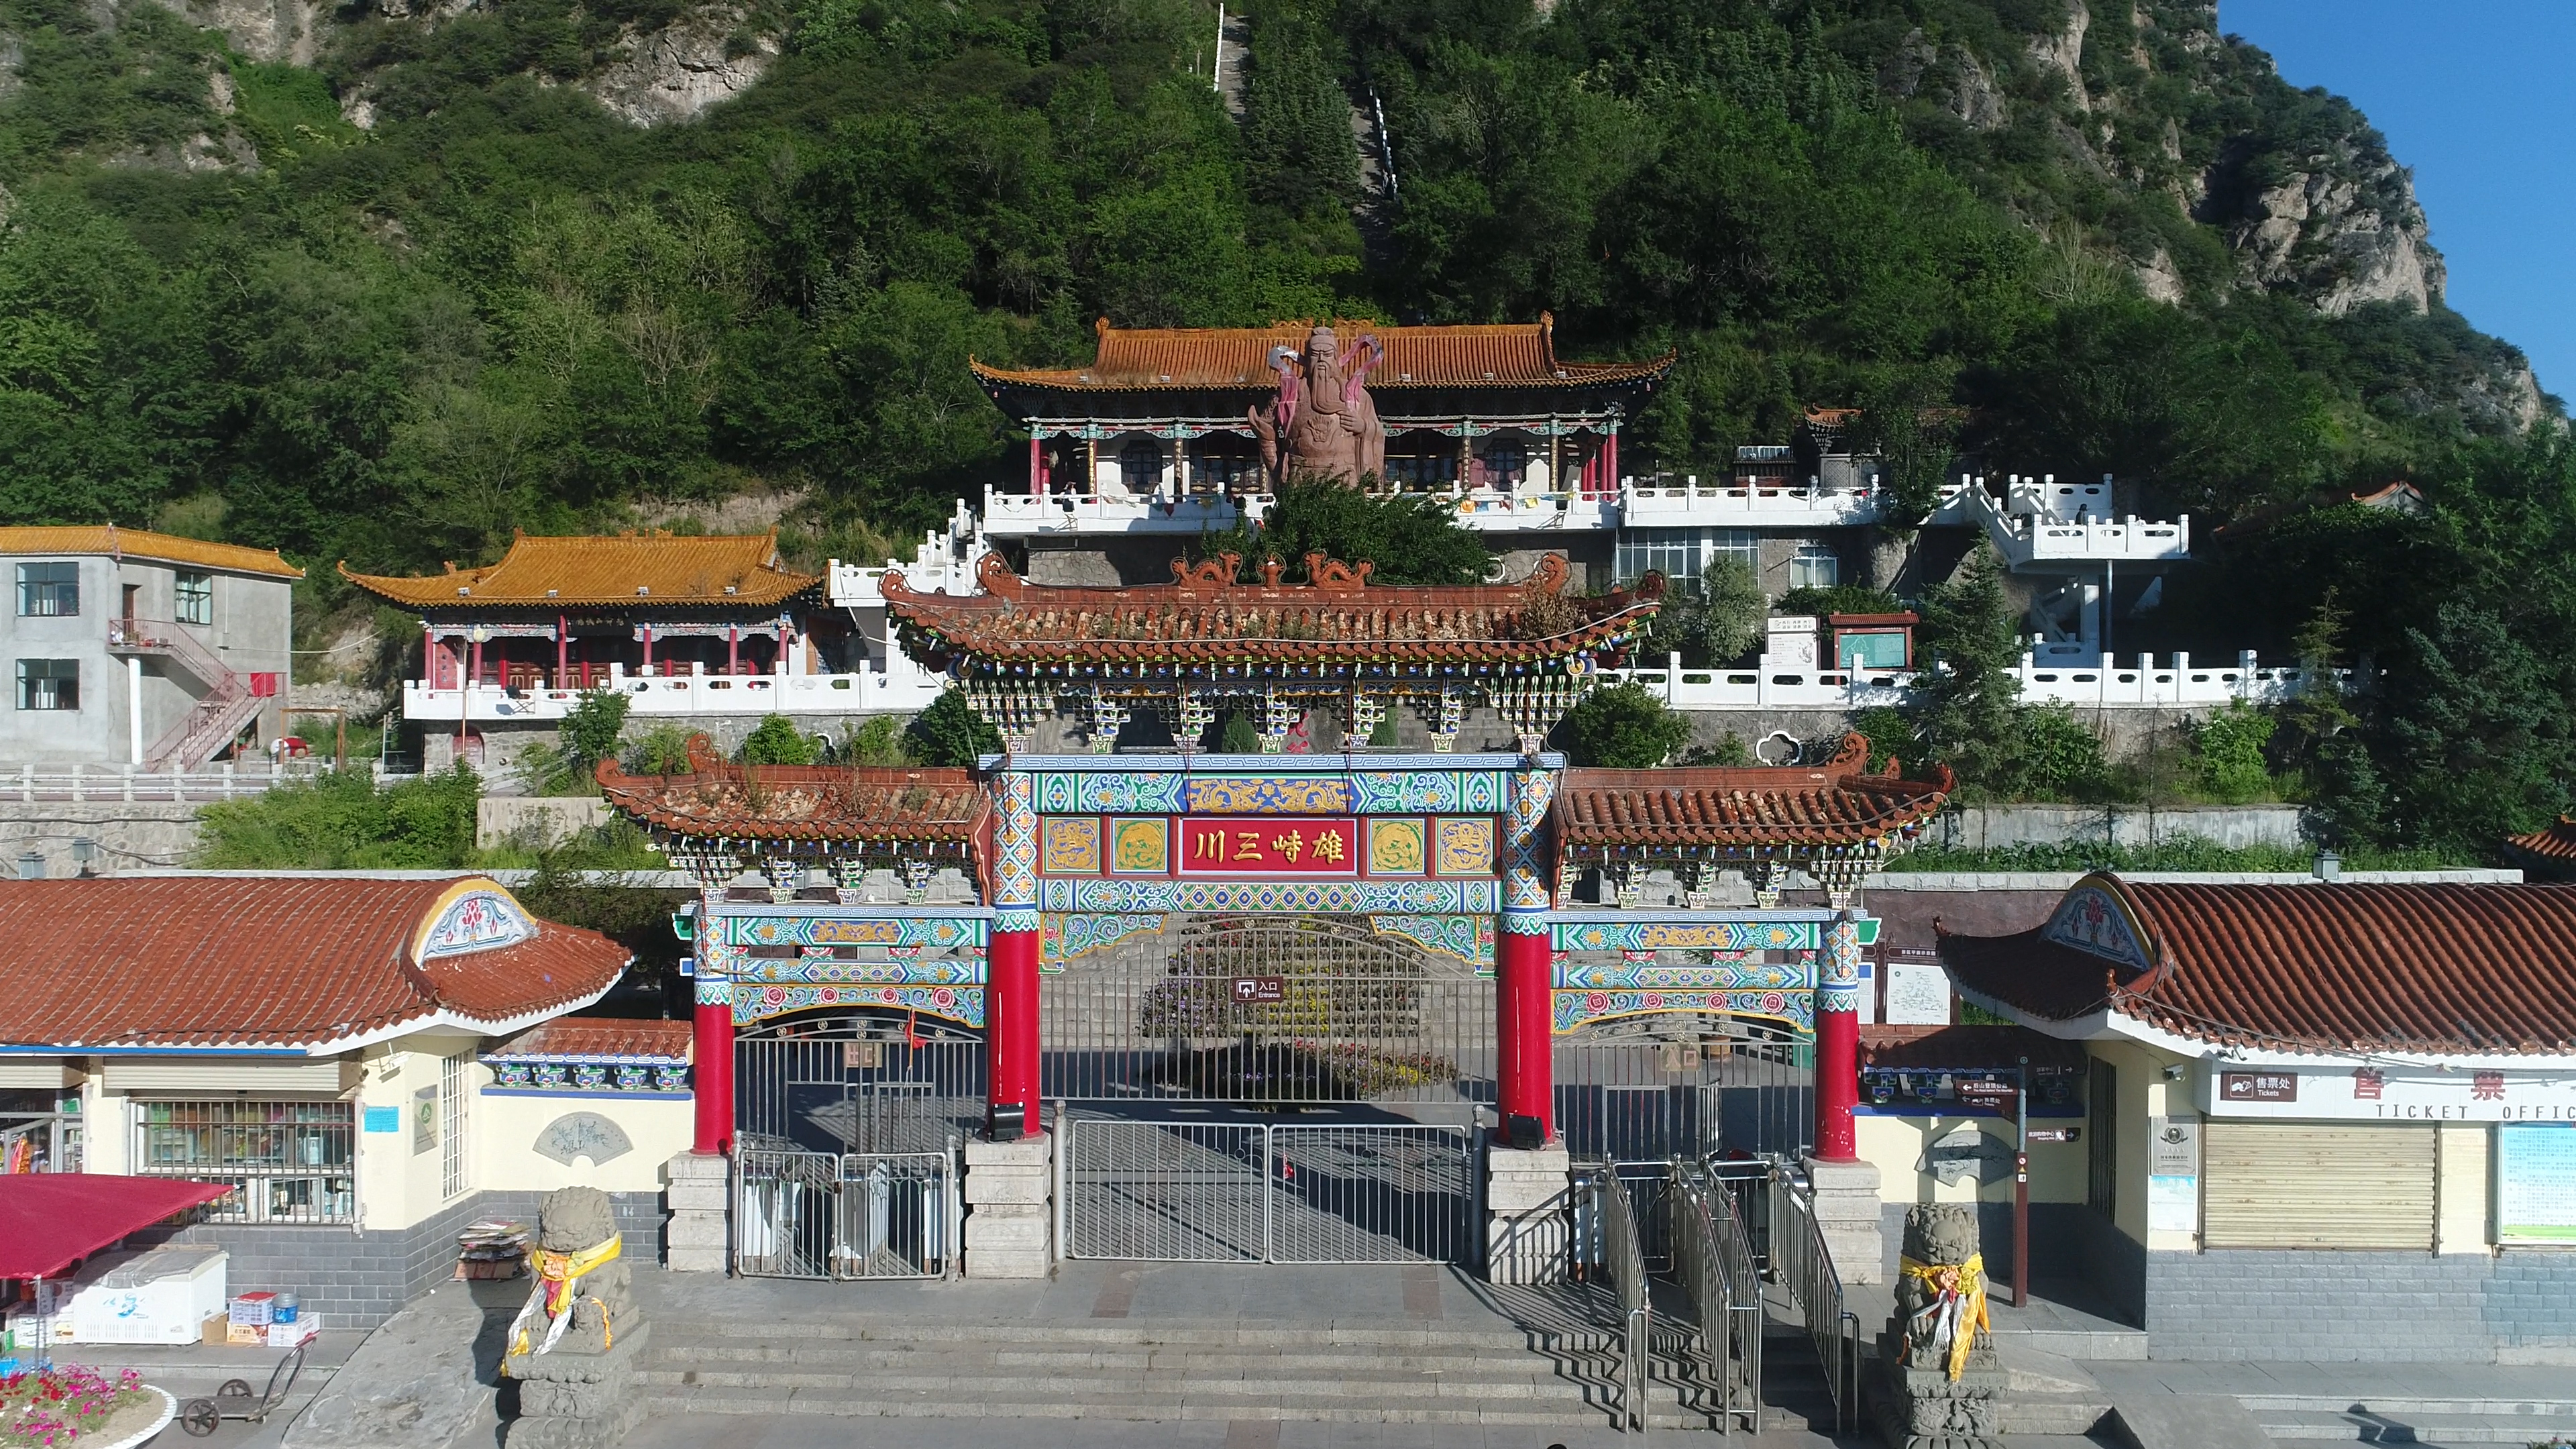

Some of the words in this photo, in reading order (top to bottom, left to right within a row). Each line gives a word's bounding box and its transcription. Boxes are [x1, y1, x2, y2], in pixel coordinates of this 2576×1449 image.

[1258, 981, 1277, 991] 入口
[1666, 1047, 1697, 1067] 入口
[2256, 1077, 2290, 1090] 售票处
[2375, 1104, 2469, 1119] TICKET
